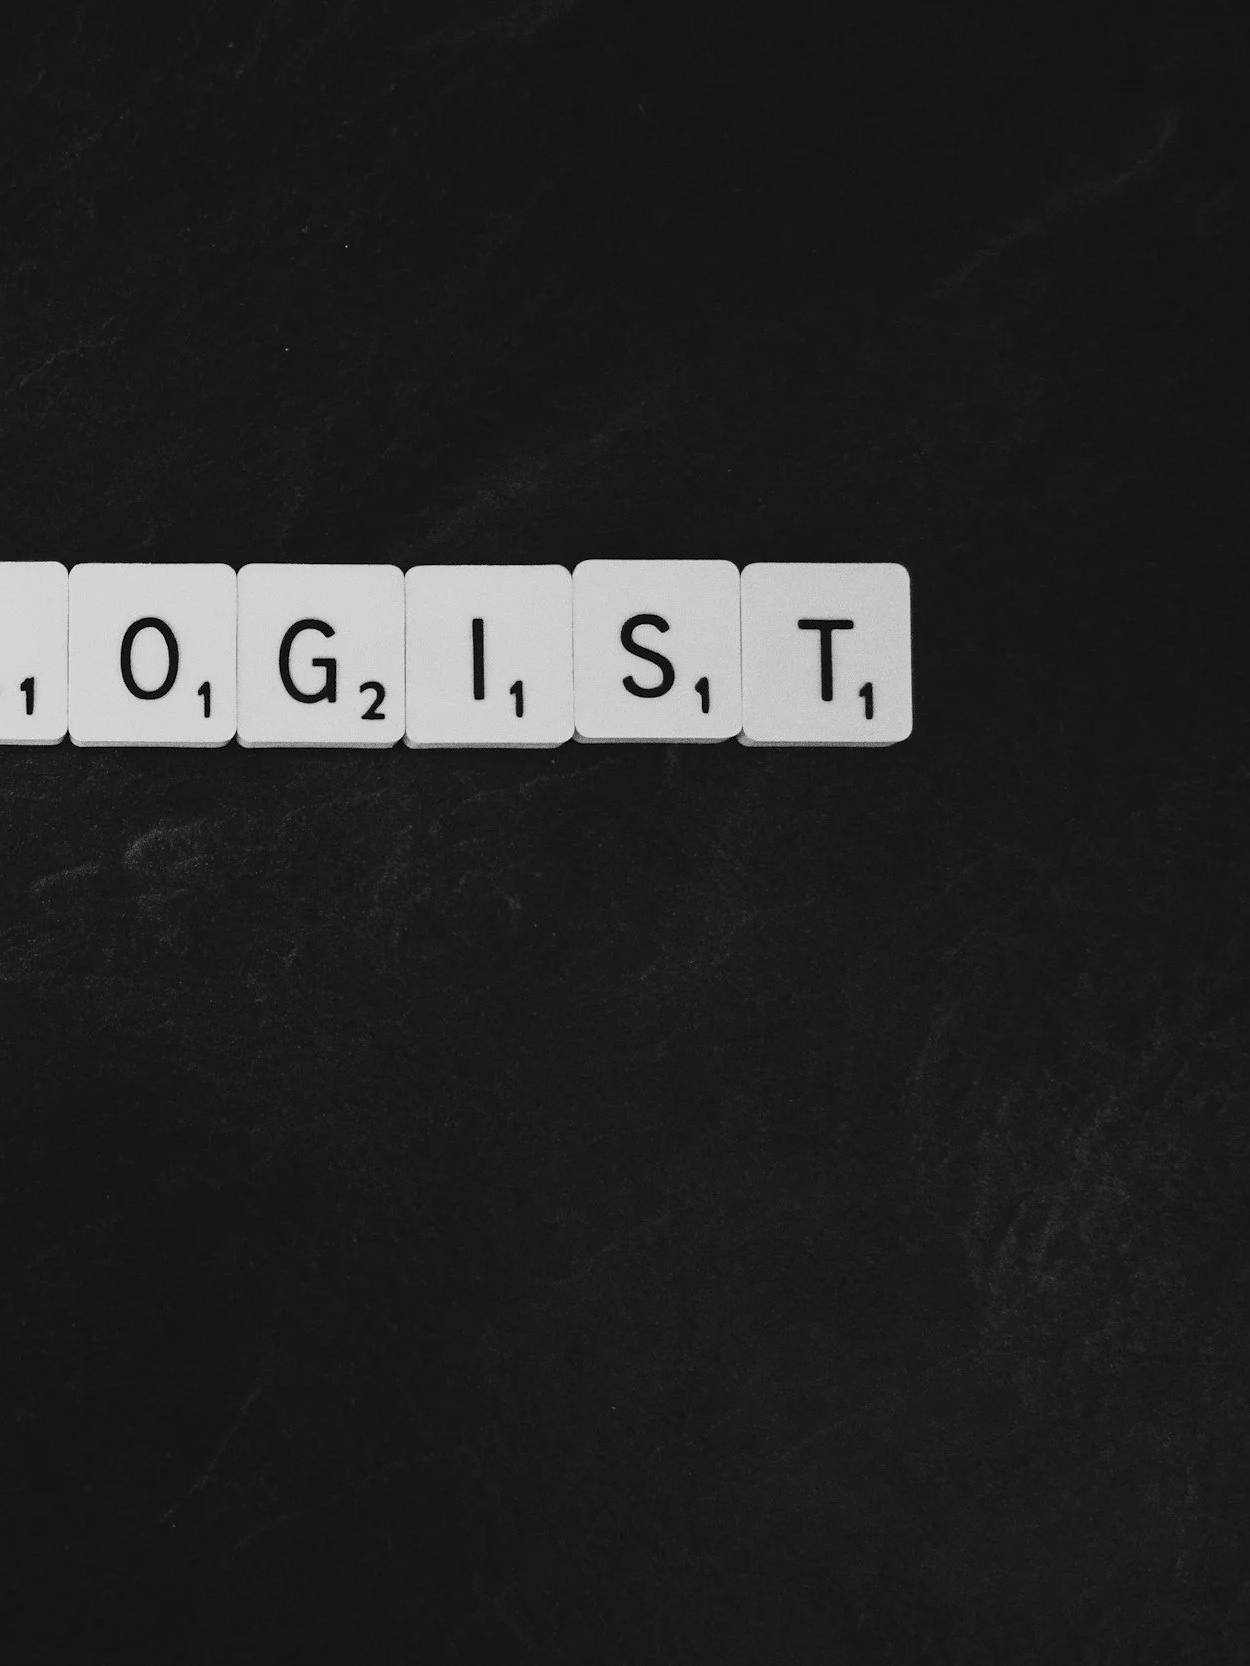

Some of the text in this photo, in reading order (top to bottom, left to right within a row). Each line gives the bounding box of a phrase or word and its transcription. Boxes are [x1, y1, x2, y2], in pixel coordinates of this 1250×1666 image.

[19, 676, 35, 716] 1
[197, 680, 212, 719] 1
[359, 680, 386, 721] 2
[509, 679, 524, 719] 1
[694, 676, 711, 715] 1
[858, 681, 875, 721] 1
